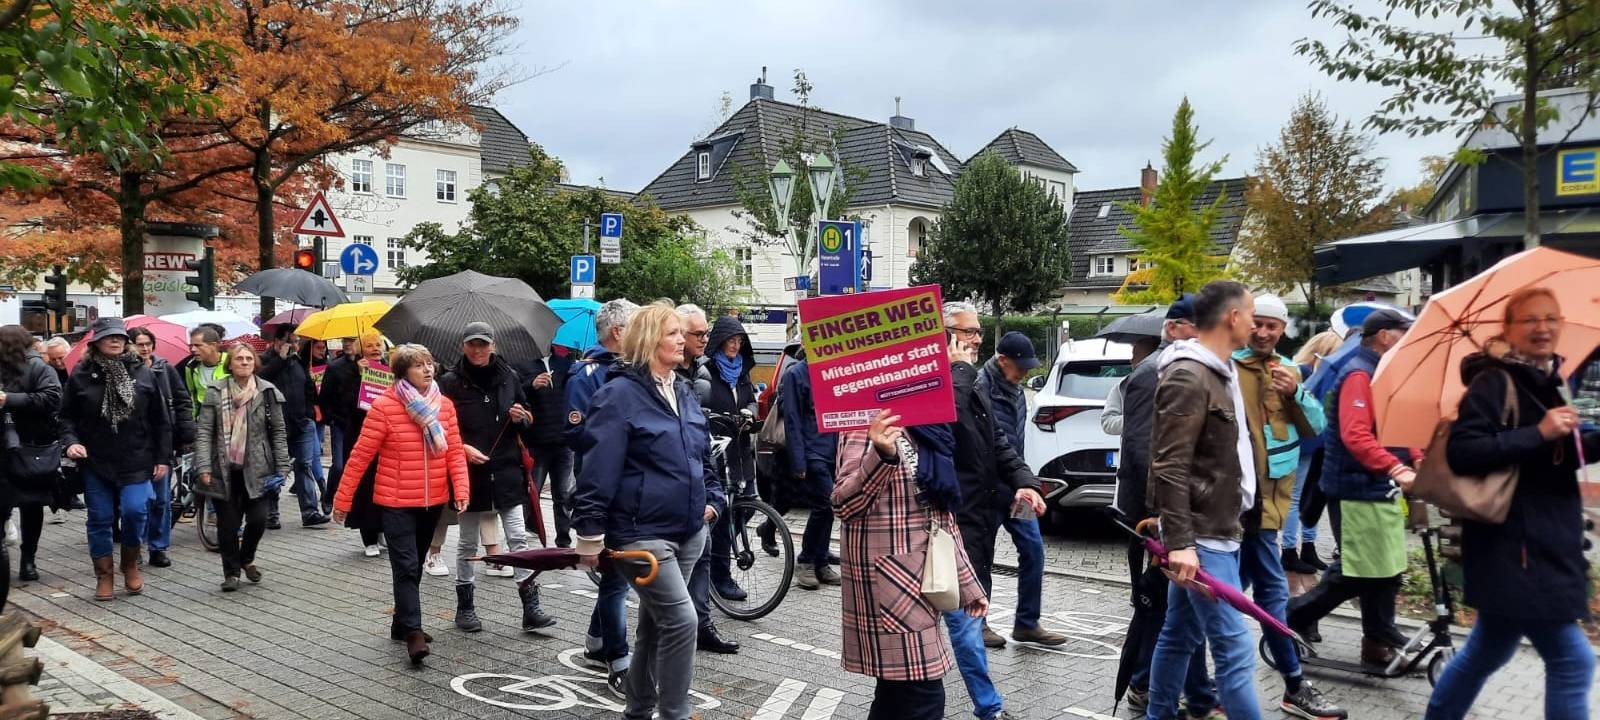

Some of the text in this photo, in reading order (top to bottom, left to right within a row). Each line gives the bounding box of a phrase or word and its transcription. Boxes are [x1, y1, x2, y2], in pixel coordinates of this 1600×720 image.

[606, 217, 617, 235] P
[827, 229, 851, 251] H 1
[576, 260, 588, 279] P
[808, 297, 934, 343] FINGER WEG
[813, 318, 938, 358] VON UNSERER RÜ!
[821, 343, 941, 381] Miteinander statt
[833, 361, 939, 397] gegeneinander!
